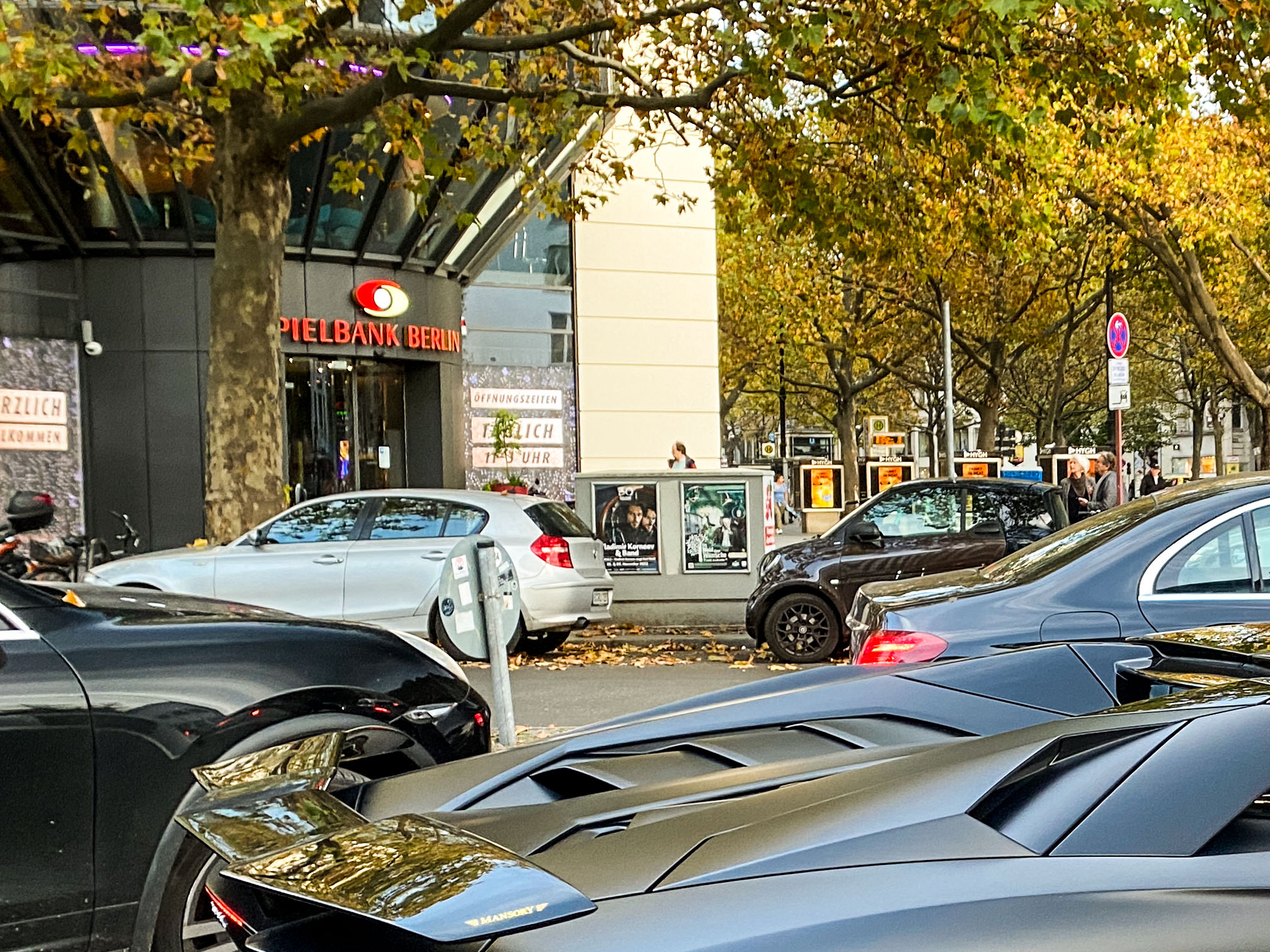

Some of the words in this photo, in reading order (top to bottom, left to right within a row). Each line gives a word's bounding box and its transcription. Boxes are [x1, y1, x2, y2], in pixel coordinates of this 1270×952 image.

[408, 325, 460, 353] BERLIN
[1, 396, 61, 416] RZLICH
[474, 392, 557, 404] ÖFFNUNGSZEITEN
[482, 423, 554, 439] TLICH
[522, 451, 551, 464] UHR
[480, 905, 534, 925] MANSORY
